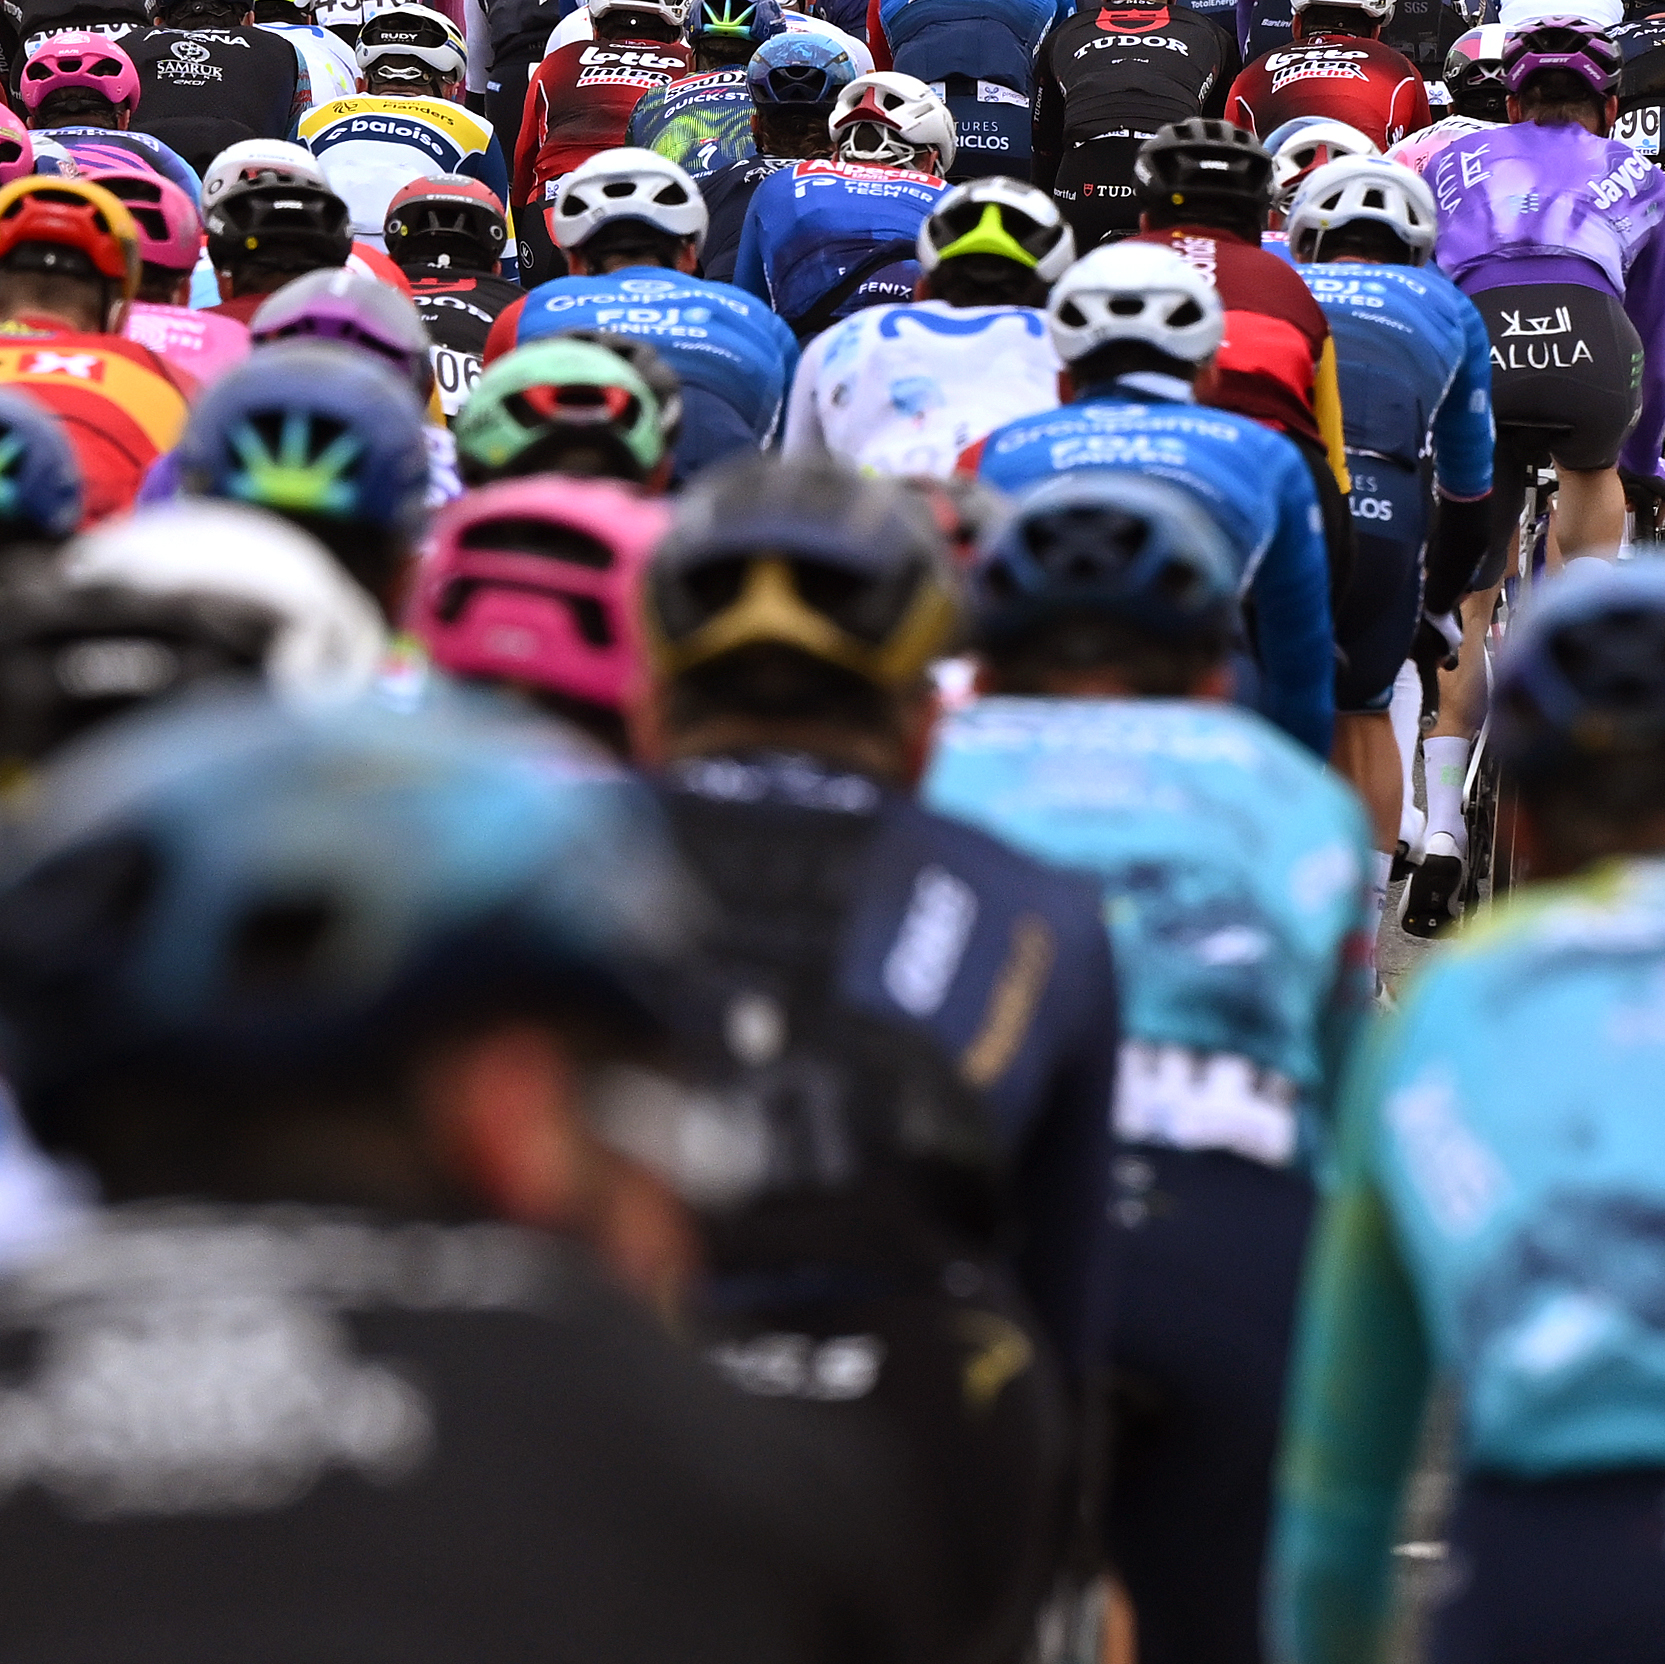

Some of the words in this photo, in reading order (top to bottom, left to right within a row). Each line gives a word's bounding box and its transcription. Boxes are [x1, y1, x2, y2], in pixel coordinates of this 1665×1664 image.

[1404, 0, 1429, 14] SGS
[579, 47, 685, 68] Lotto
[1073, 35, 1190, 60] TUDOR
[157, 61, 223, 76] SAMRUK
[1264, 50, 1370, 72] Lotto
[666, 71, 747, 99] SOUDA
[382, 103, 456, 127] Flanders
[1033, 86, 1044, 122] TUDOR
[351, 119, 445, 156] baloise
[807, 160, 932, 184] Alpecin
[1586, 149, 1651, 209] Jayco
[844, 180, 935, 203] PREMIER
[846, 188, 900, 199] TECH
[1097, 185, 1137, 197] TUD
[859, 283, 911, 297] FENIX
[1316, 293, 1384, 307] NITED
[546, 289, 749, 317] Groupama
[598, 309, 680, 325] FDJ
[1489, 339, 1594, 372] ALULA
[437, 351, 483, 394] 06
